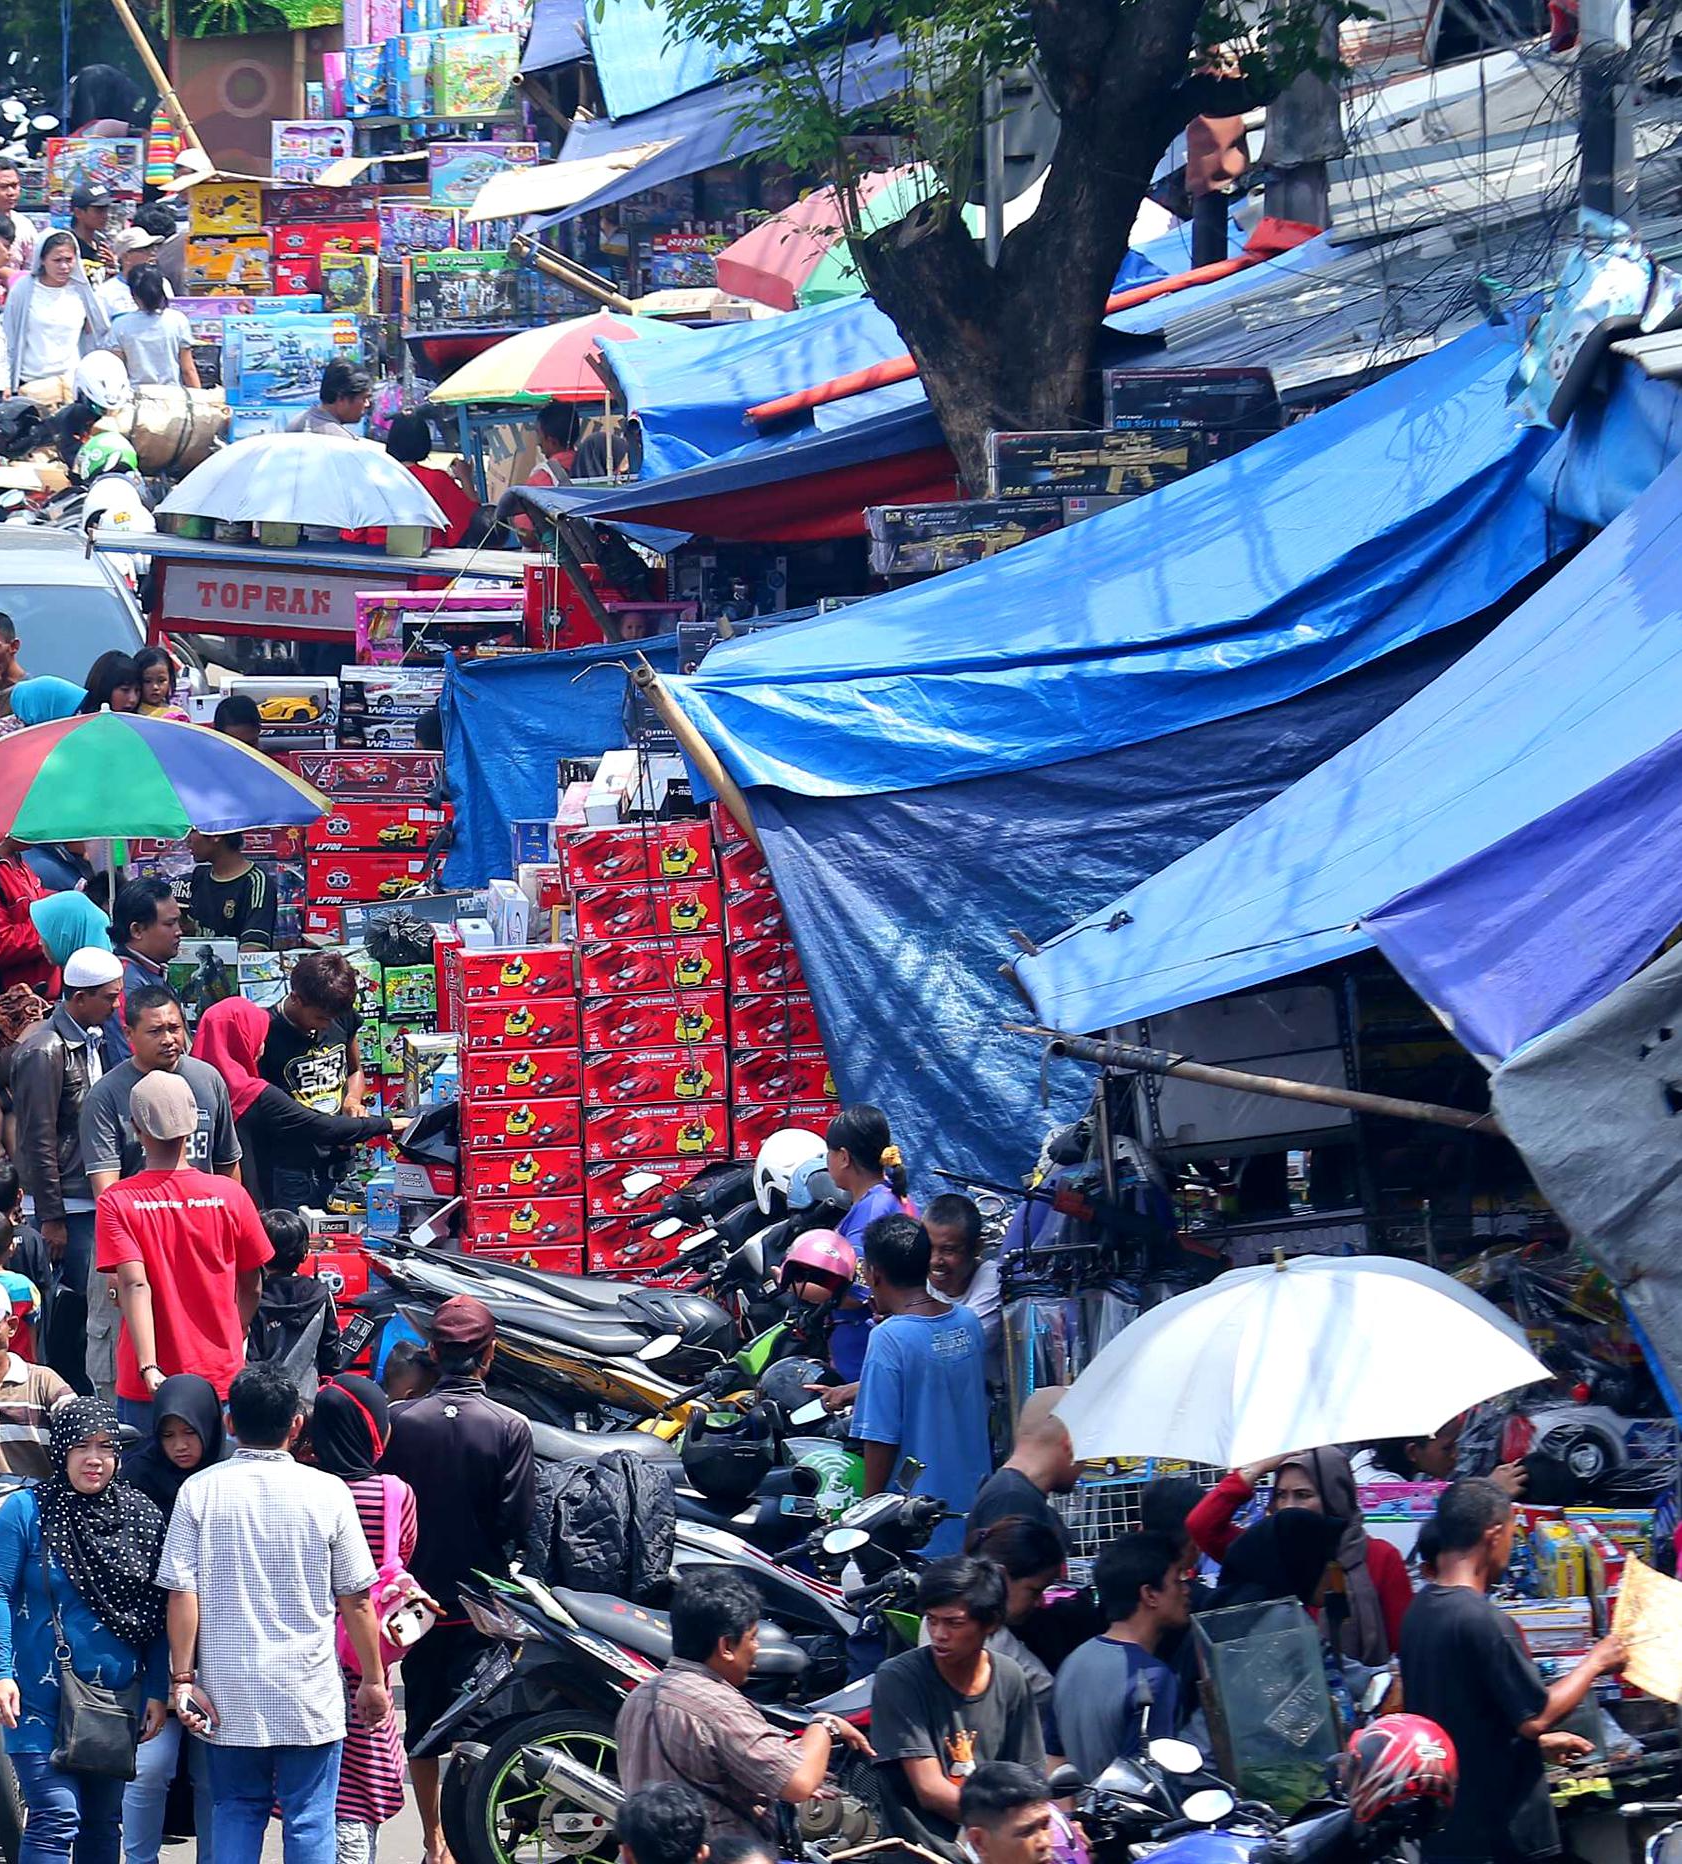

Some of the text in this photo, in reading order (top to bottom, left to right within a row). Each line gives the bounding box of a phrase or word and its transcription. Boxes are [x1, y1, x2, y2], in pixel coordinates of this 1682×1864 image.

[196, 581, 332, 616] TOPRAK
[315, 843, 343, 851] LP700
[315, 896, 343, 904] LP700
[133, 1196, 225, 1211] Supporter Persija
